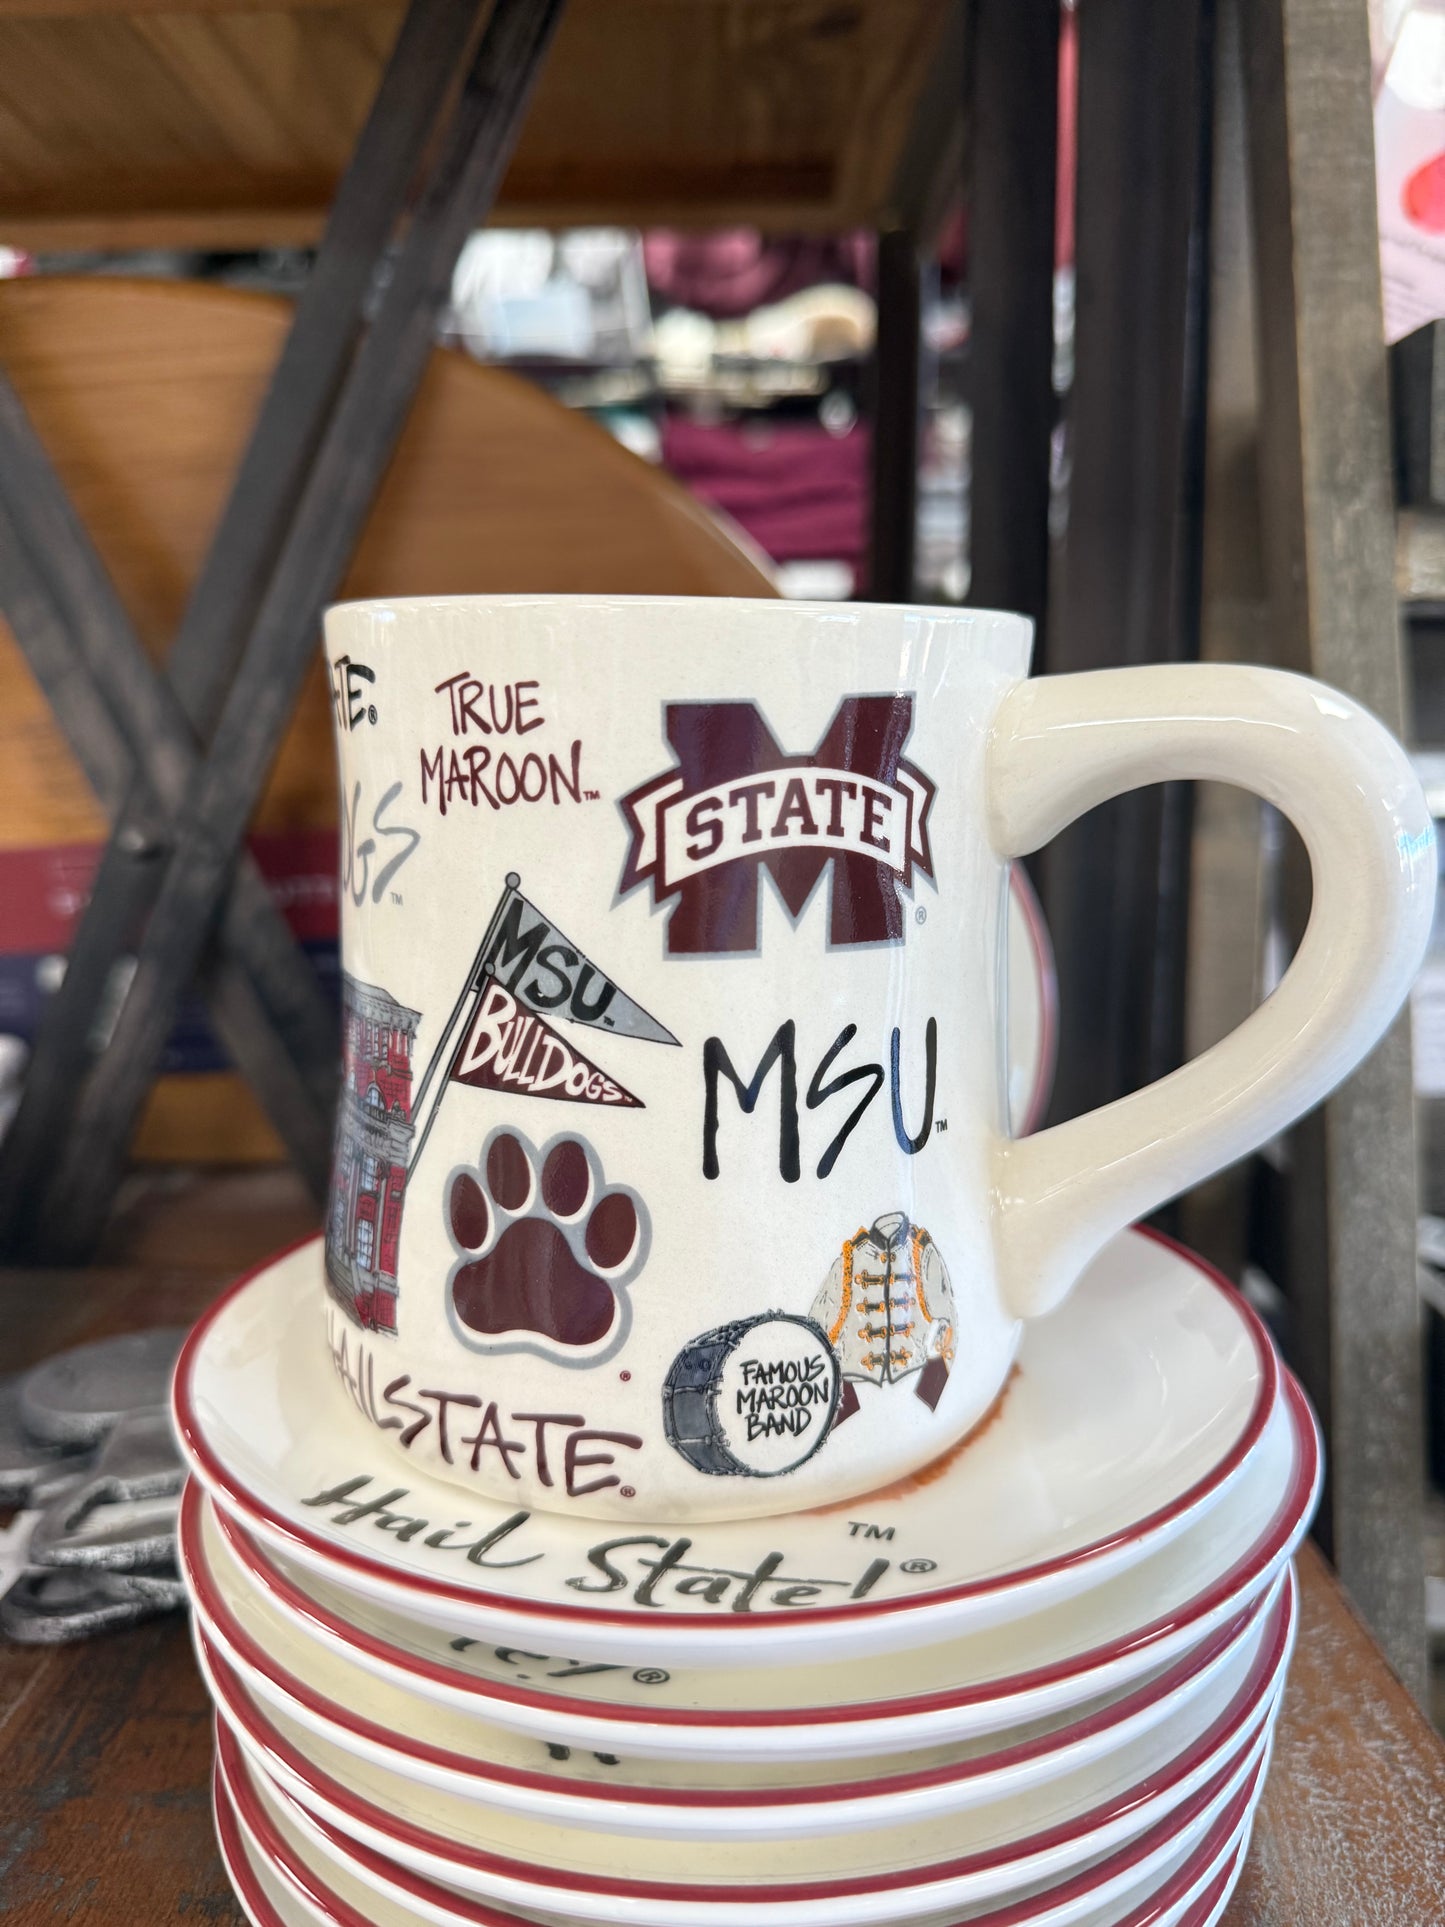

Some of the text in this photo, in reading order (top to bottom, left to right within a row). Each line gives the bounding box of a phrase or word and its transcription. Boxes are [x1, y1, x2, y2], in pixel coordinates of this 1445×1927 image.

[434, 671, 545, 736] TRUE
[420, 739, 582, 816] MAROON
[685, 778, 893, 860] STATE
[475, 898, 617, 1021] MSU
[703, 1017, 937, 1183] MSU
[736, 1380, 829, 1414] MAROON
[740, 1353, 826, 1385] FAMOUS
[383, 1374, 643, 1497] STATE
[747, 1406, 812, 1442] BAND
[301, 1474, 545, 1568] Hail
